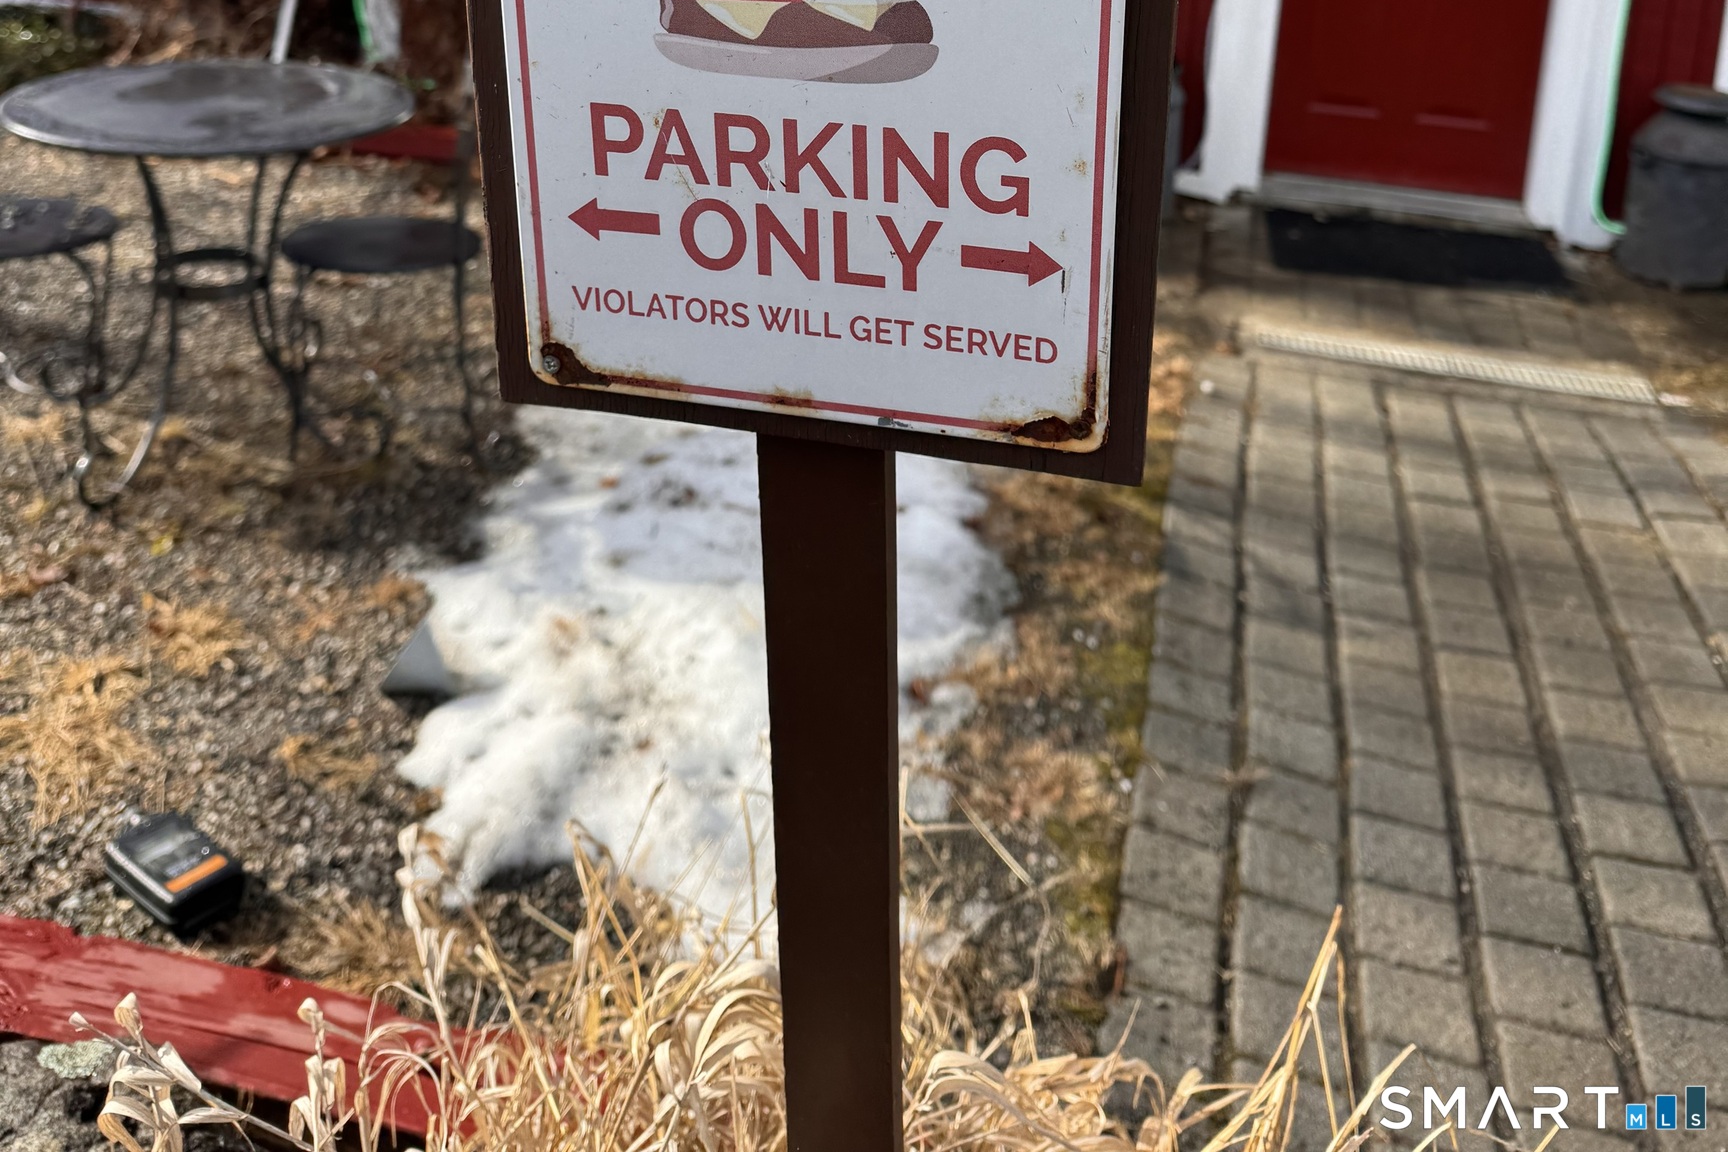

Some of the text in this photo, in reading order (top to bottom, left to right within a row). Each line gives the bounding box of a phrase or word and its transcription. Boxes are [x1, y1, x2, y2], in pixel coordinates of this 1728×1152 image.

[589, 102, 1029, 217] PARKING
[679, 198, 943, 292] ONLY
[571, 285, 1059, 365] VIOLATORS WILL GET SERVED
